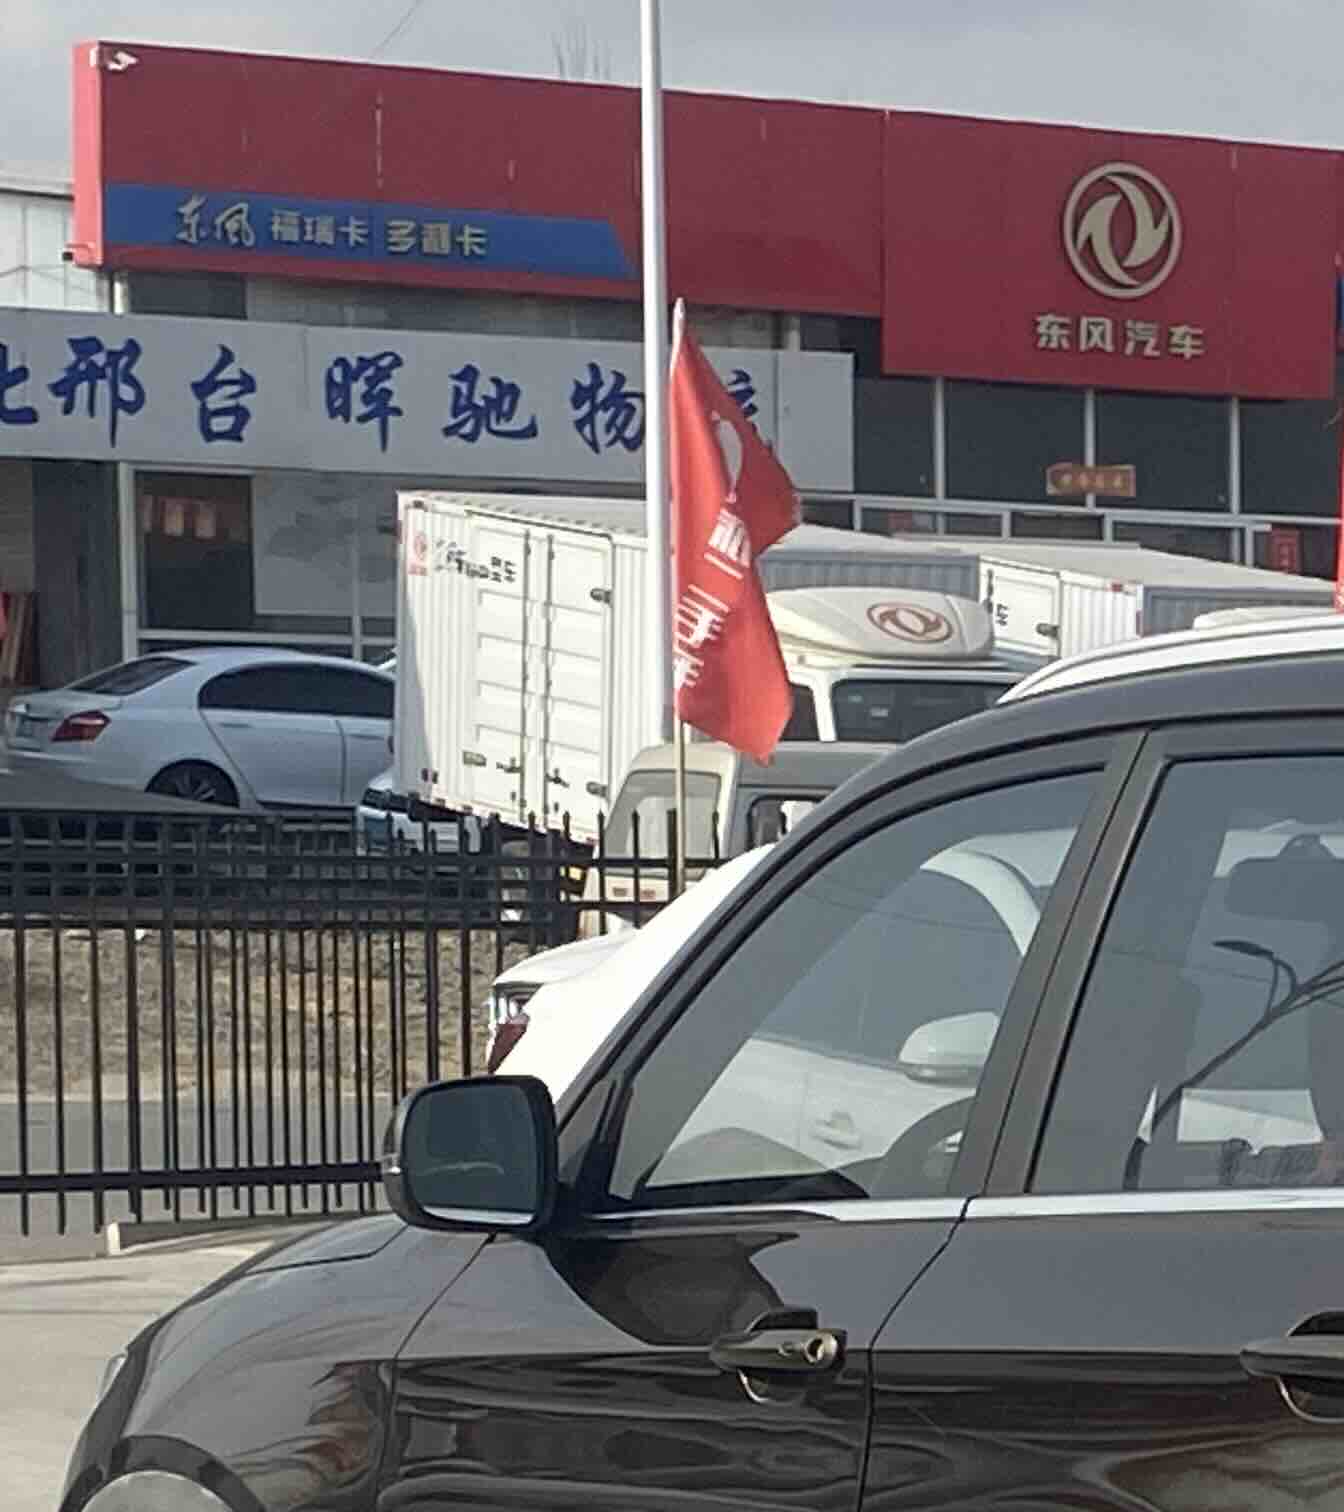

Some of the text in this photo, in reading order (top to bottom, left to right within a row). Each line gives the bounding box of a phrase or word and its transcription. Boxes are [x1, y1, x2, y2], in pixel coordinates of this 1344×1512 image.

[1035, 313, 1205, 360] 东风汽车
[0, 335, 758, 453] 邢台晖驰物
